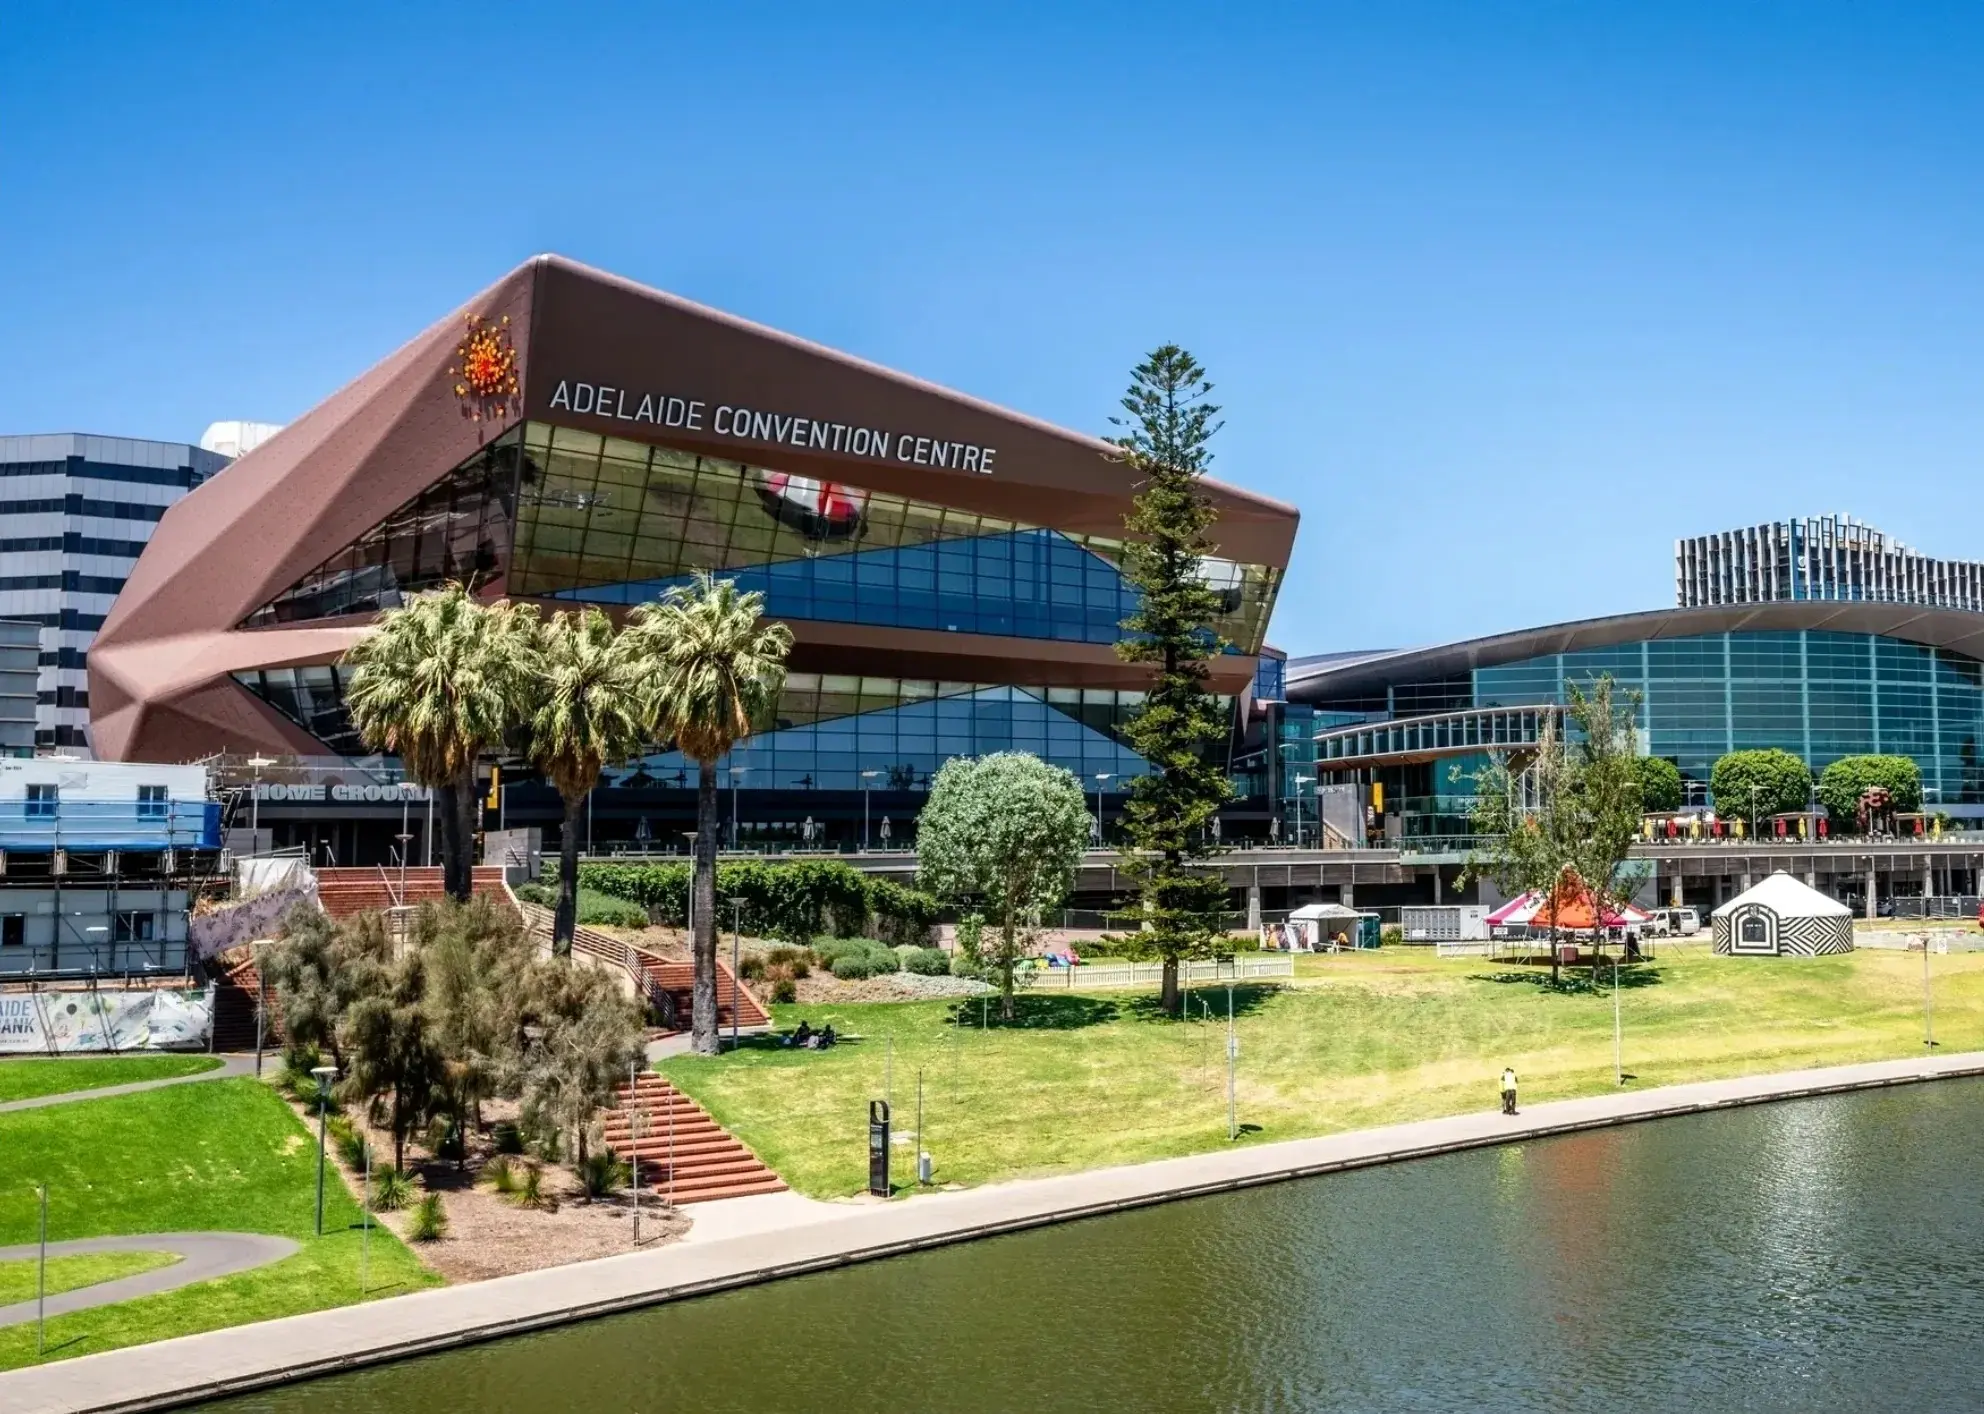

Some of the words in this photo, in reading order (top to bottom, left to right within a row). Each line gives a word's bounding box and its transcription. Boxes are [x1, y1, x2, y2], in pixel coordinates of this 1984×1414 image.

[549, 380, 705, 431] ADELAIDE
[713, 405, 890, 459] CONVENTION
[897, 434, 997, 474] CENTRE
[251, 783, 326, 800] HOME
[0, 1017, 35, 1034] ANK
